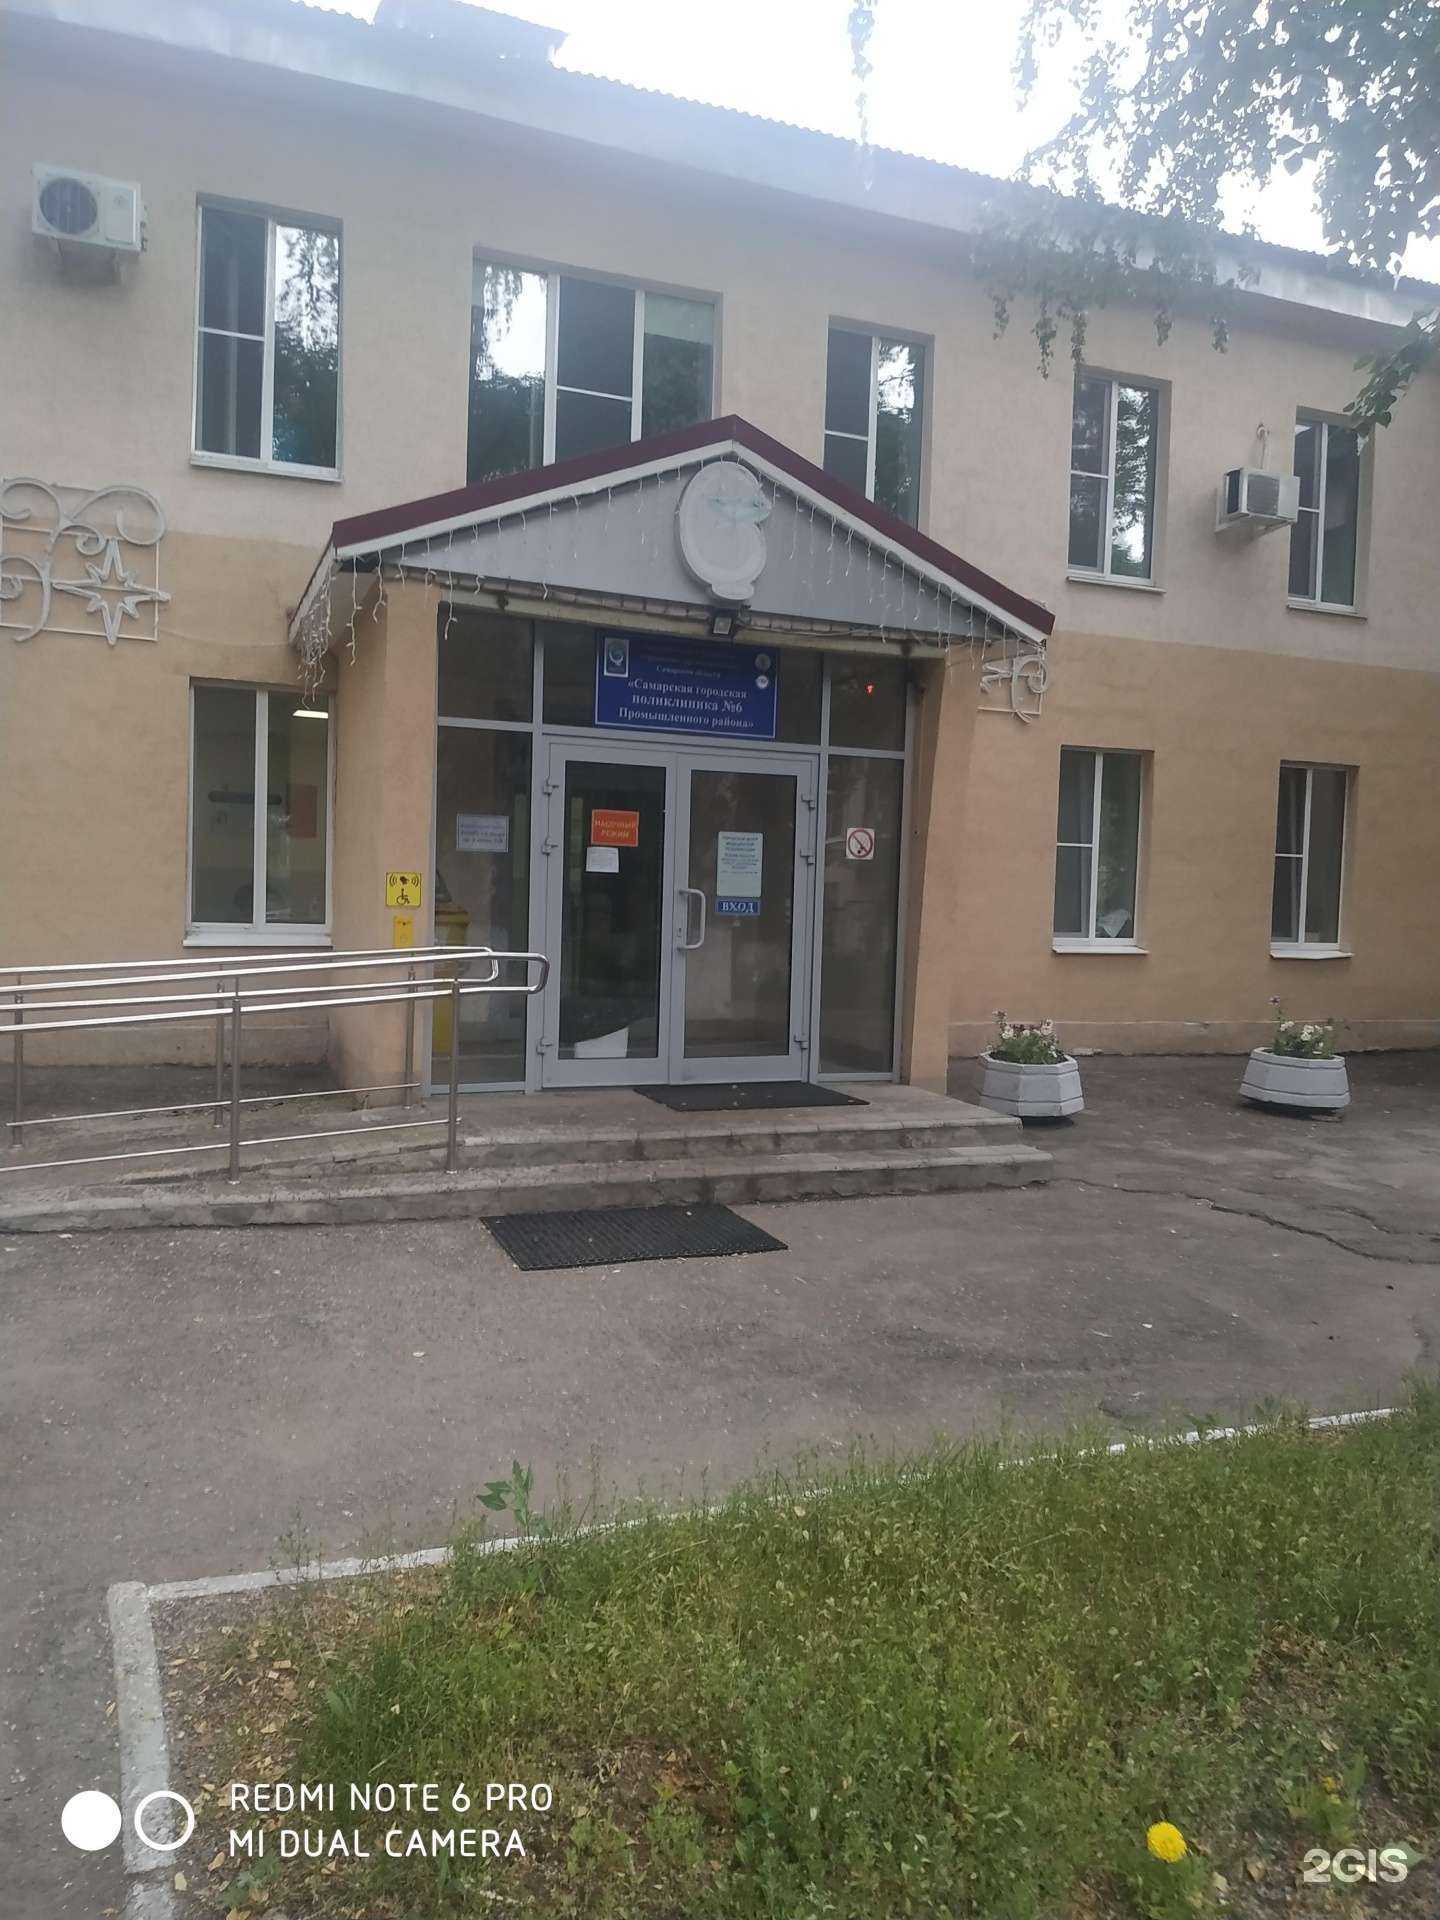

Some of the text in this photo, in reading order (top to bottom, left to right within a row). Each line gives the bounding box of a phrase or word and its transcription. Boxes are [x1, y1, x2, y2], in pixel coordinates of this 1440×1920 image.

[696, 686, 748, 699] городская
[632, 694, 743, 713] поликлиника №6
[619, 707, 709, 725] Промышленного
[721, 902, 754, 913] ВХОД
